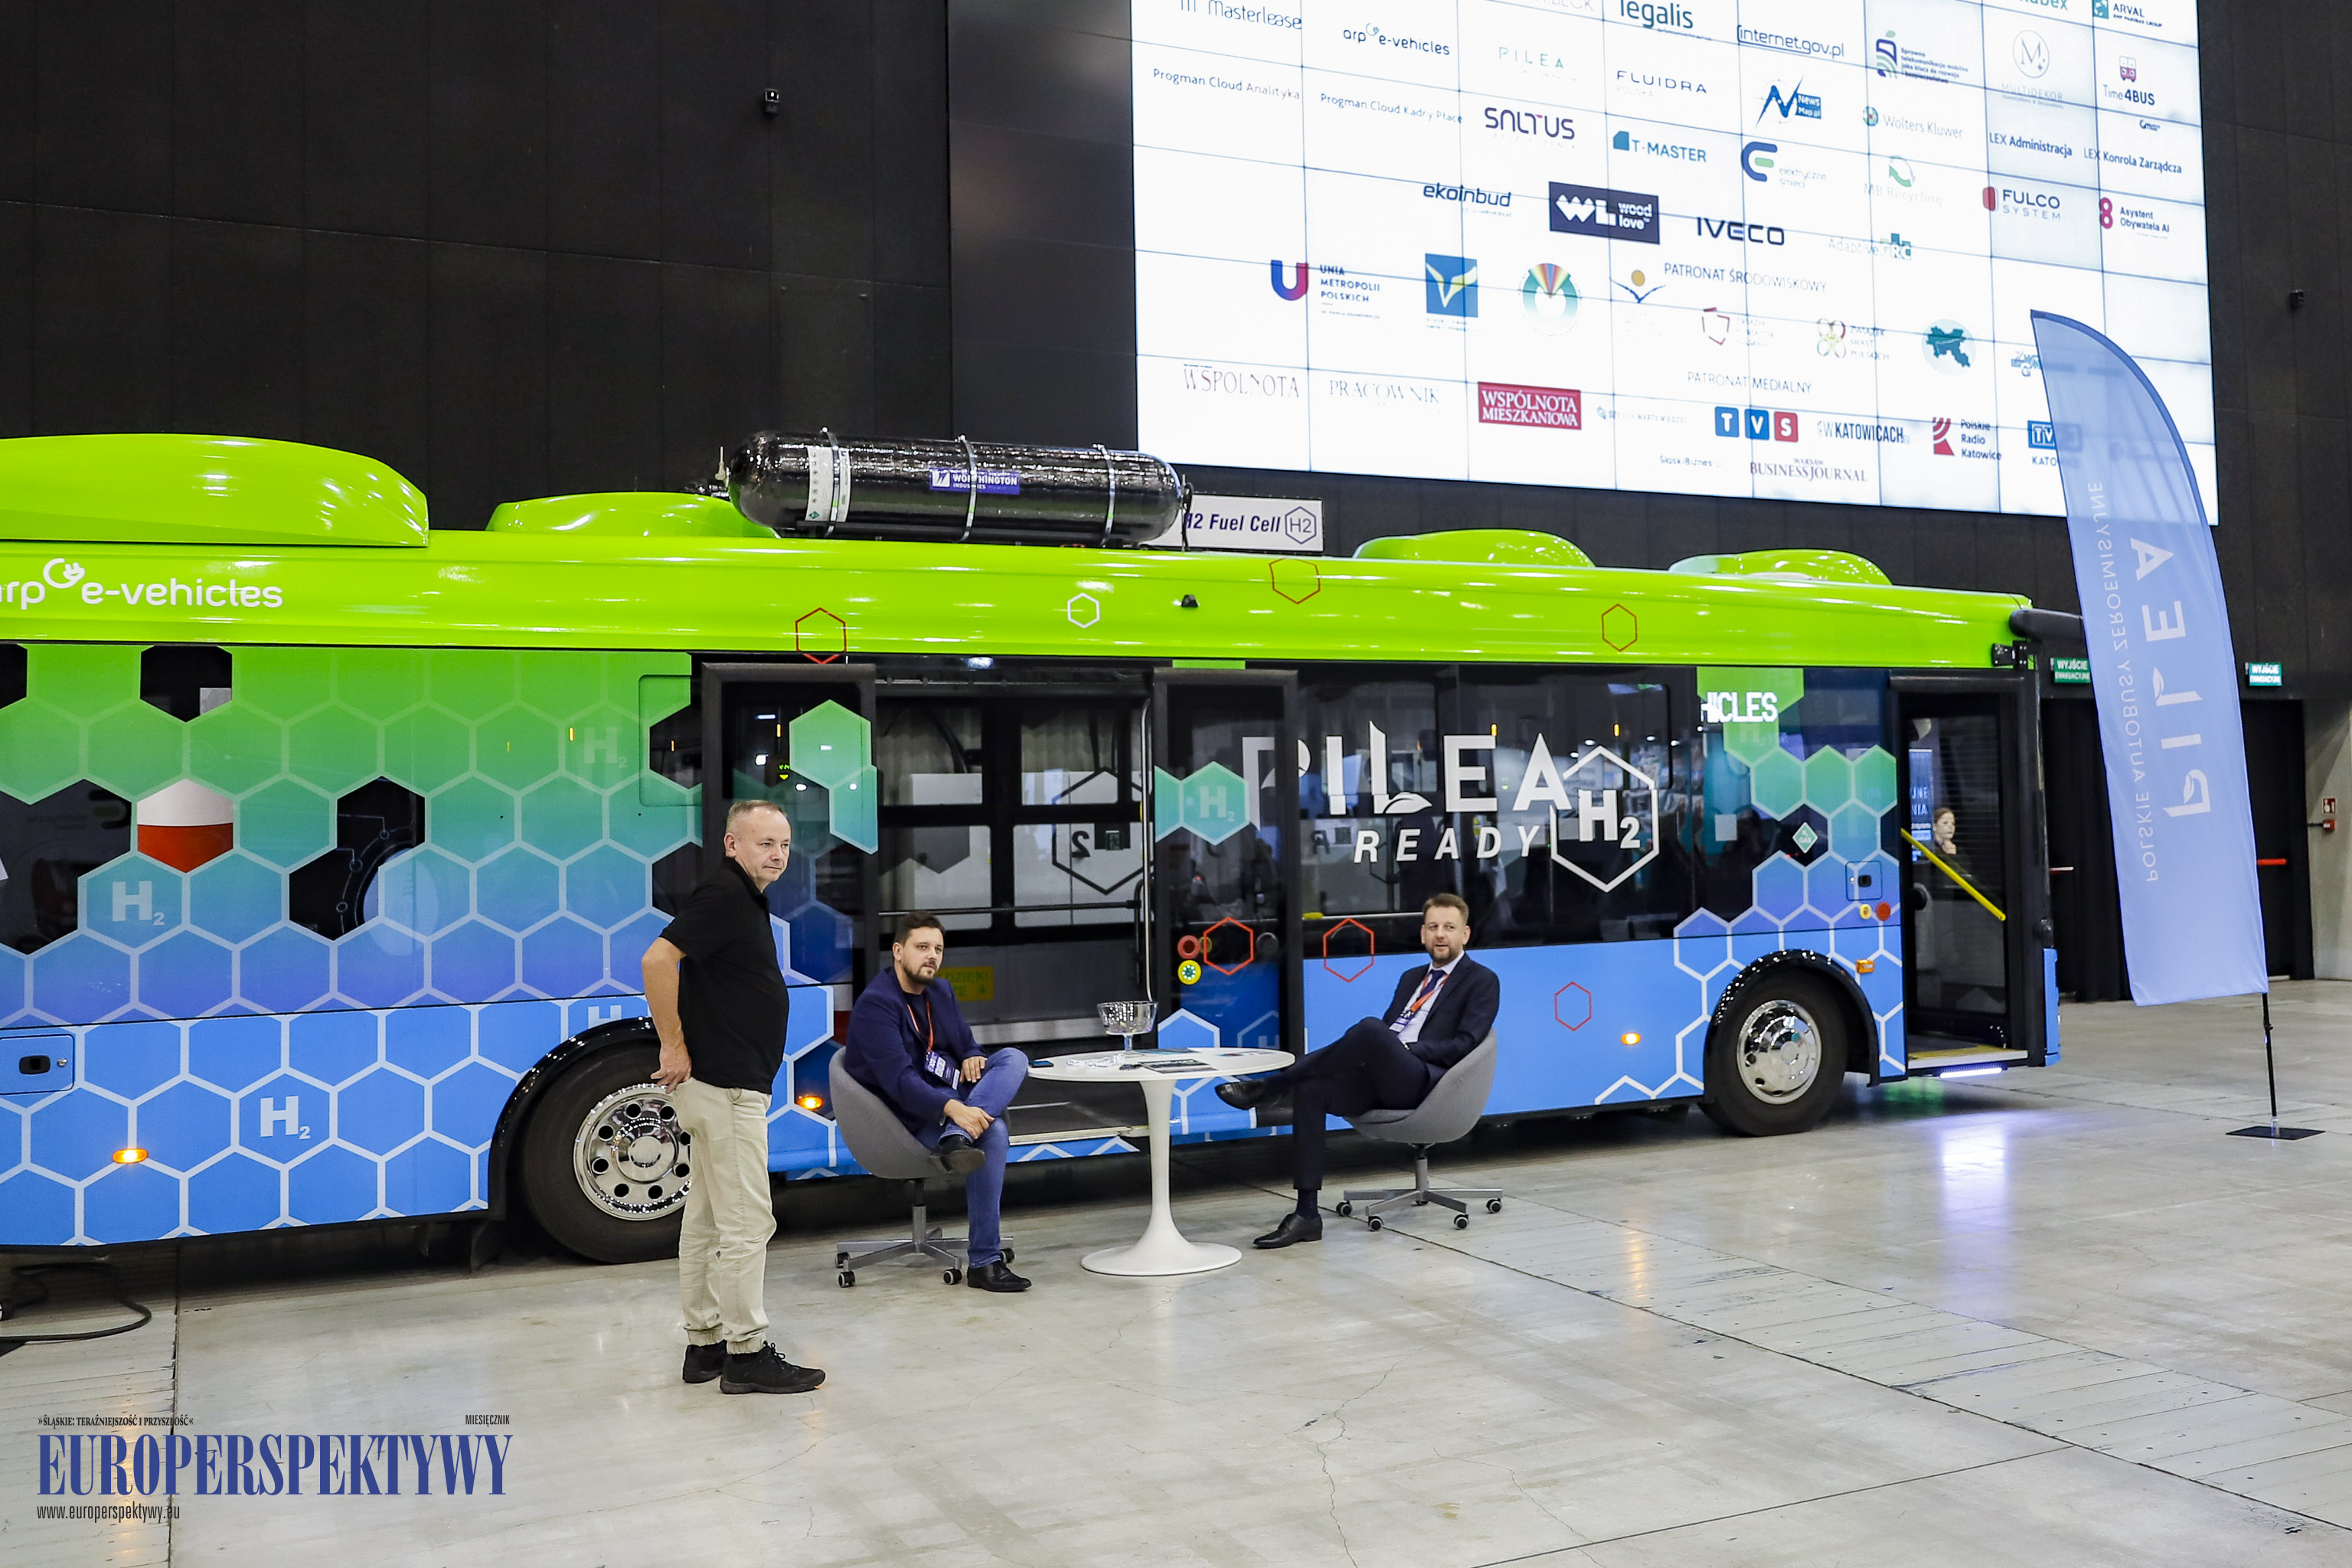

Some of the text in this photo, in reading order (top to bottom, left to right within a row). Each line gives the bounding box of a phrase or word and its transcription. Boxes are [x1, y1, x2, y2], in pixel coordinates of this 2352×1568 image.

[1207, 0, 1302, 31] Masterlease
[1620, 0, 1694, 29] legalis
[2113, 3, 2145, 19] ARVAL
[1343, 27, 1451, 57] arp e-vehicles
[1740, 26, 1845, 60] internet.gov.pl
[1498, 46, 1564, 70] PILEA
[1153, 69, 1301, 102] Progman Cloud Analityka
[1617, 70, 1707, 94] FLUIDRA
[1320, 93, 1367, 110] Progman
[1370, 100, 1401, 115] Cloud
[1403, 106, 1433, 122] Kadry
[1883, 114, 1963, 139] Wolters Kluwer
[1988, 132, 2073, 159] LEX Administracja
[2082, 147, 2101, 161] LEX
[2138, 156, 2182, 175] Zarządcza
[1423, 182, 1513, 207] ekoinbud
[2002, 188, 2061, 210] FULCO
[1618, 202, 1653, 217] wood
[2003, 204, 2062, 221] SYSTEM
[2119, 206, 2154, 220] Asystent
[1697, 217, 1785, 246] IVECO
[2120, 217, 2161, 233] Obywatela
[1319, 263, 1346, 276] UNIA
[1664, 262, 1828, 292] PATRONAT ŚRODOWISKOWY
[1320, 278, 1381, 292] METROPOLII
[1321, 290, 1370, 303] POLSKICH
[1687, 371, 1813, 394] PATRONAT MEDIALNY
[1481, 388, 1578, 414] WSPÓLNOTA
[1481, 405, 1579, 427] MIESZKANIOWA
[1720, 411, 1793, 438] TVS
[1961, 433, 1986, 446] Radio
[952, 473, 1018, 486] WOHINGTON
[1209, 513, 1245, 531] Fuel
[1250, 514, 1282, 533] Cell
[1289, 517, 1313, 534] H2
[80, 577, 284, 609] e-vehicles
[1353, 824, 1540, 864] READY
[111, 880, 165, 926] H2
[260, 1095, 311, 1141] H2
